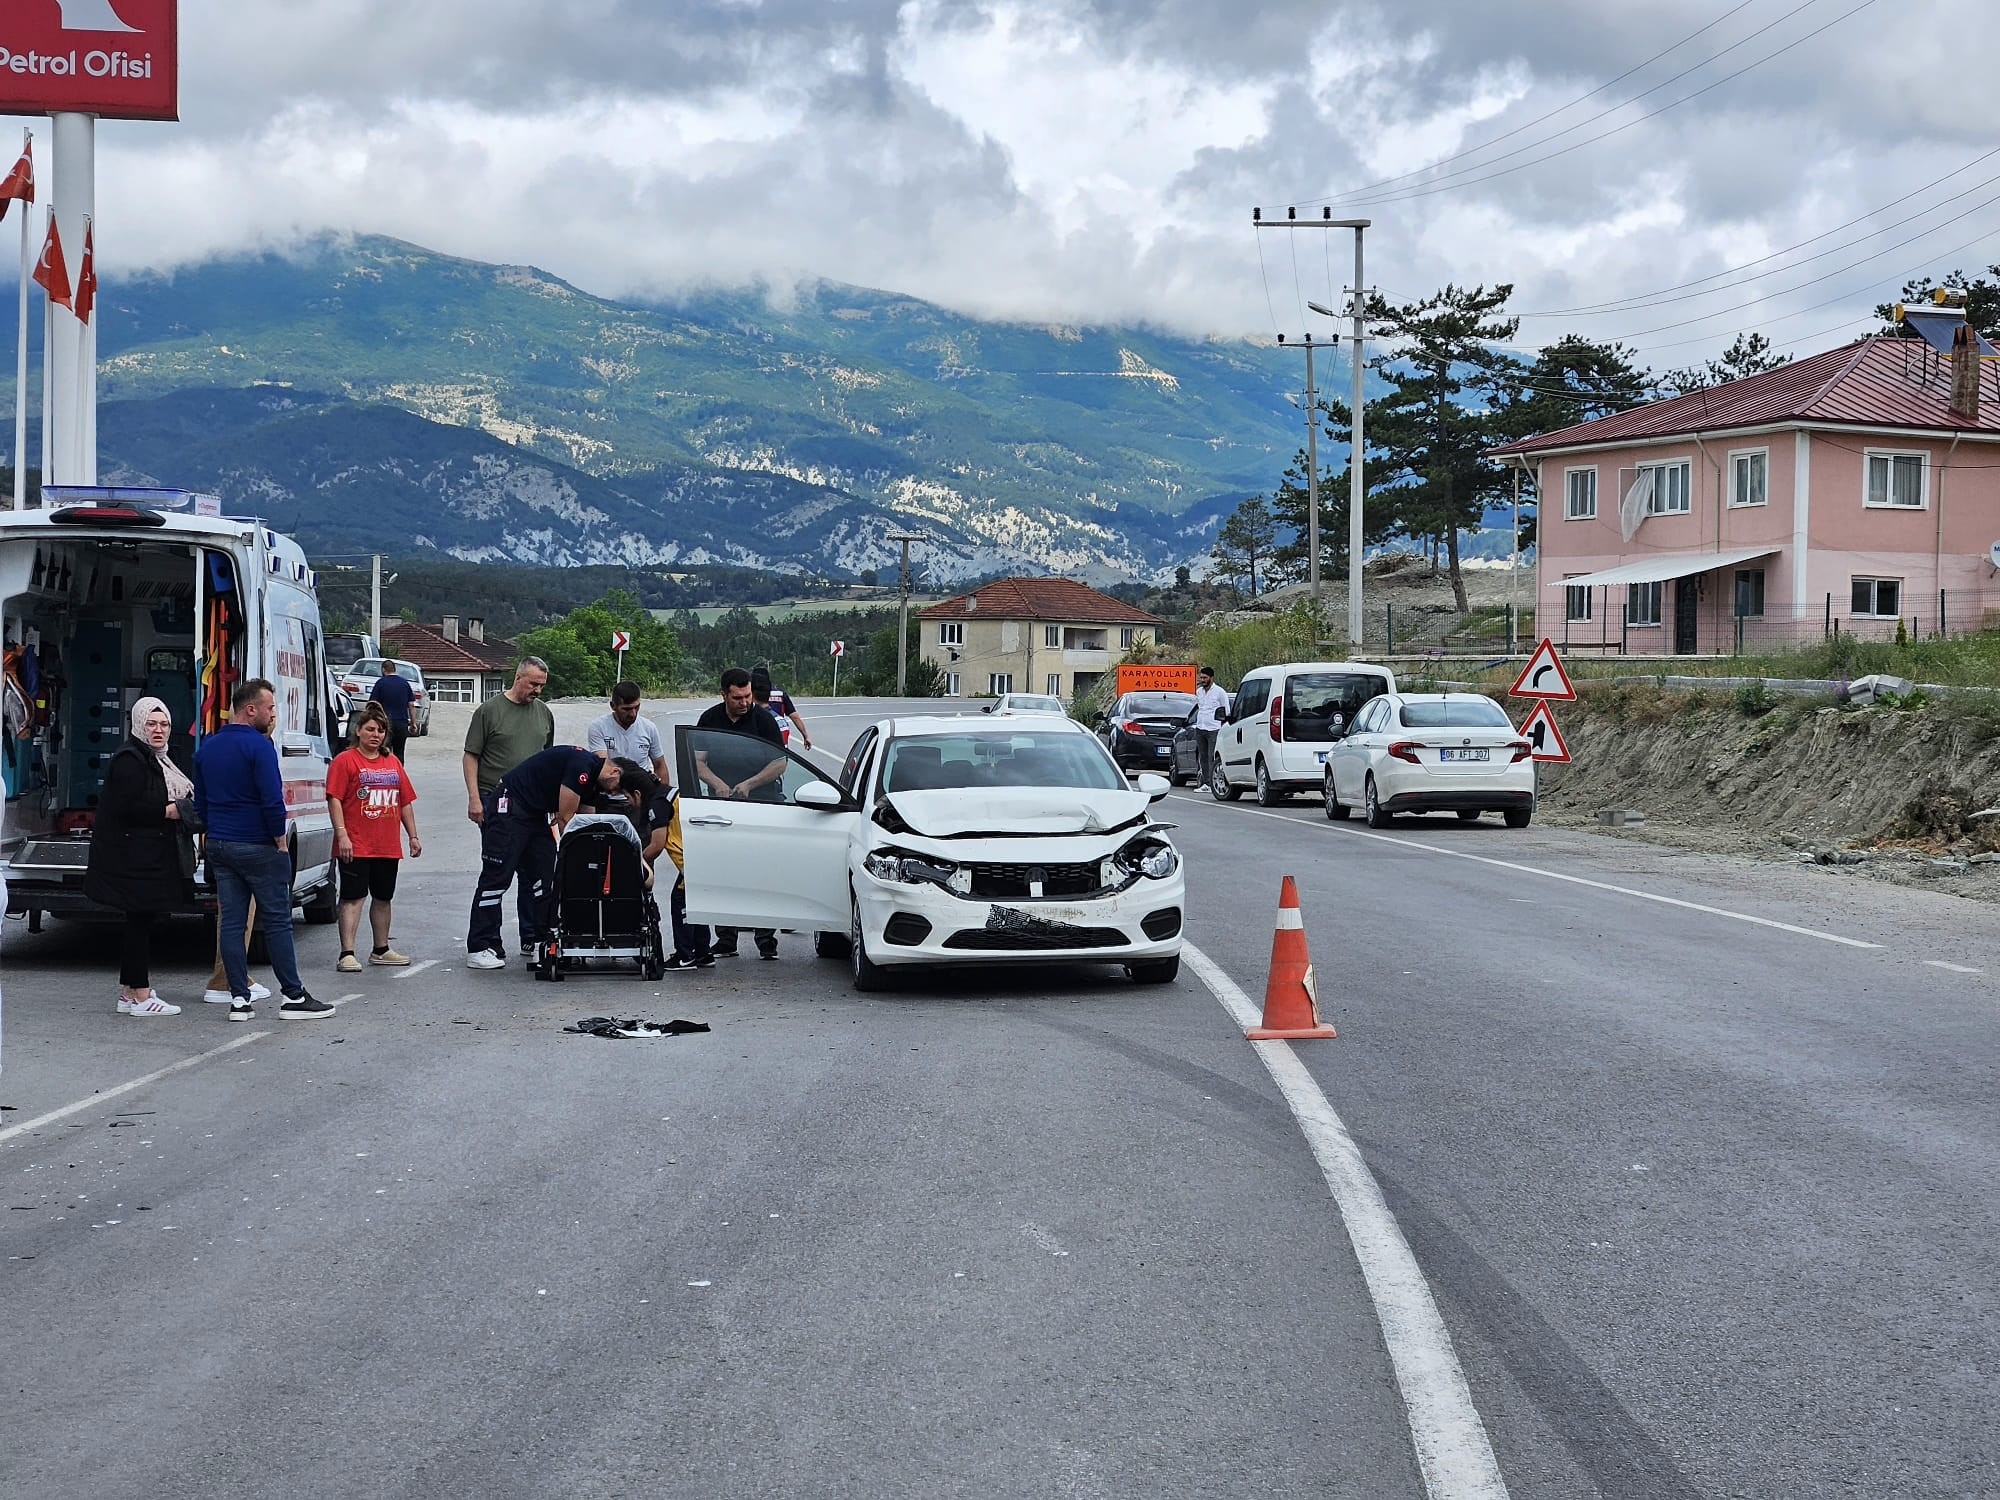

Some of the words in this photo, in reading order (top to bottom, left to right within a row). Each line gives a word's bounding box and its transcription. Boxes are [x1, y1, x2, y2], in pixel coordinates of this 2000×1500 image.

[84, 50, 151, 78] Ofisi
[1122, 670, 1192, 678] KARAYOLLARI
[288, 686, 299, 730] 112
[1446, 750, 1454, 758] 06
[1458, 750, 1472, 758] AFT
[1474, 750, 1488, 759] 307
[368, 788, 400, 806] NYC
